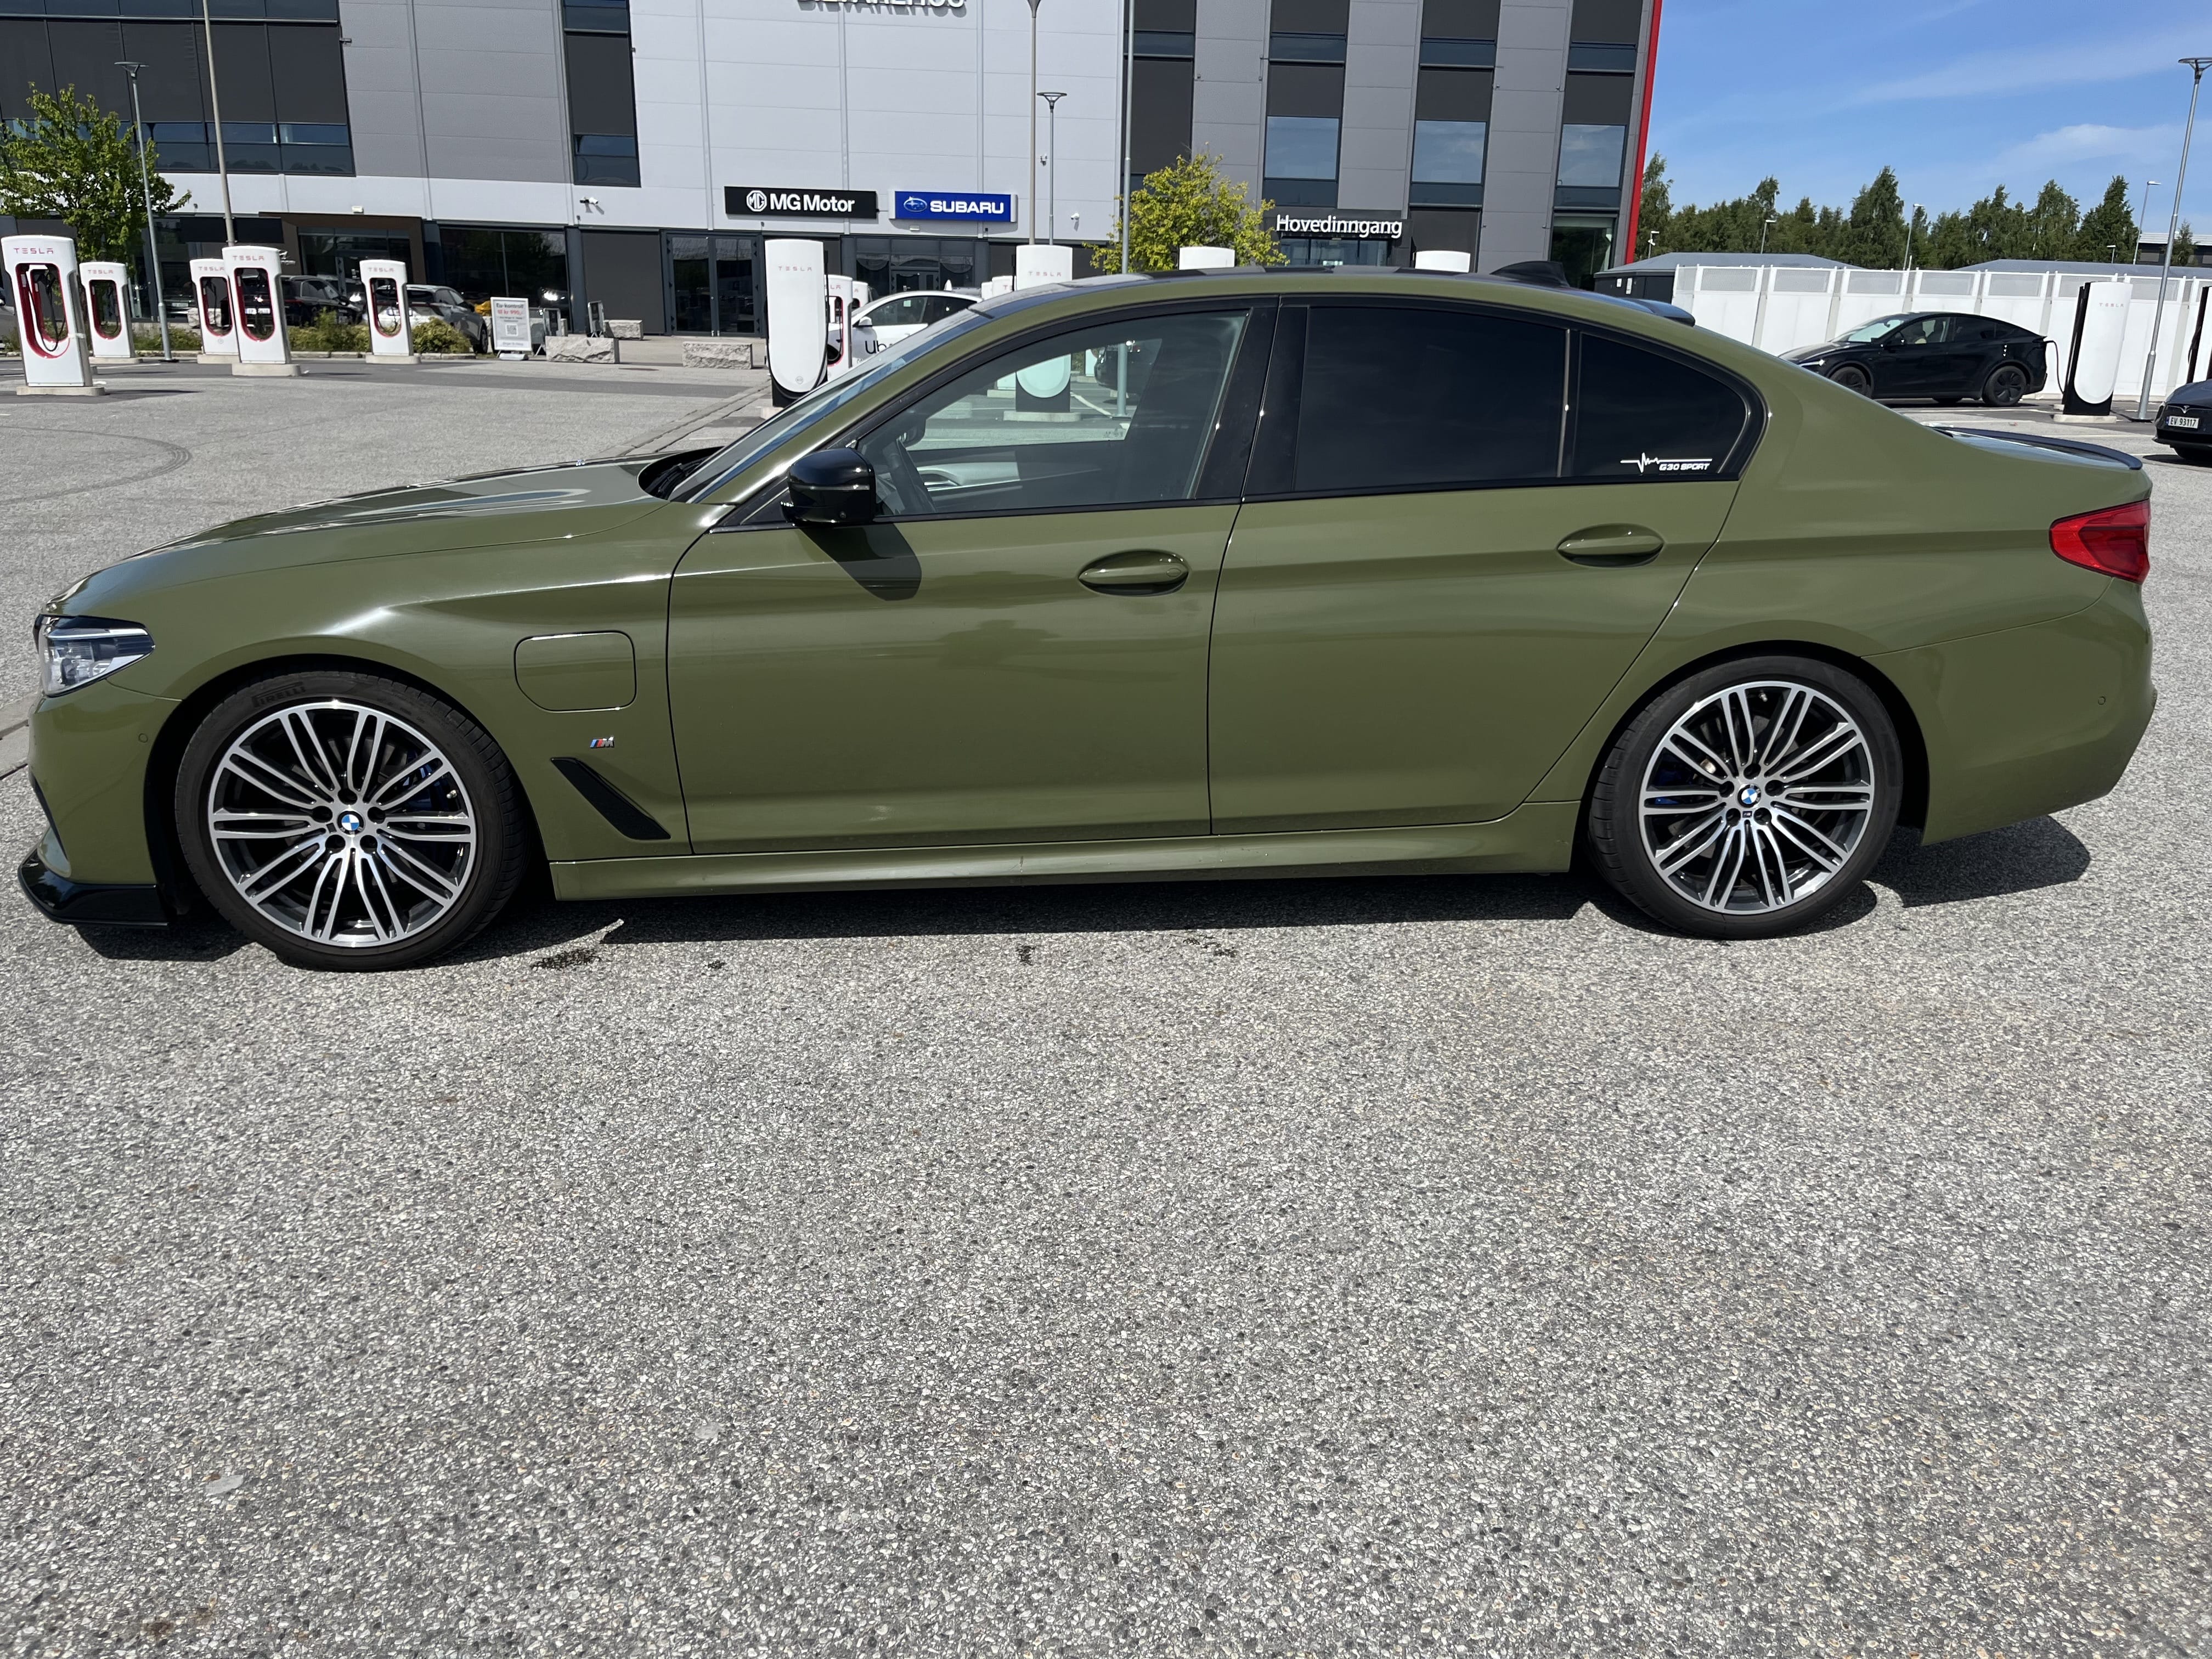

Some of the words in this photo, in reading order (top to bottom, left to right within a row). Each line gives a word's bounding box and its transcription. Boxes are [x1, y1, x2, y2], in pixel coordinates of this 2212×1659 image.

[770, 193, 801, 210] MG
[803, 194, 855, 212] Motor
[930, 200, 1004, 214] SUBARU
[1276, 214, 1403, 238] Hovedinngang
[2180, 418, 2196, 426] 93117
